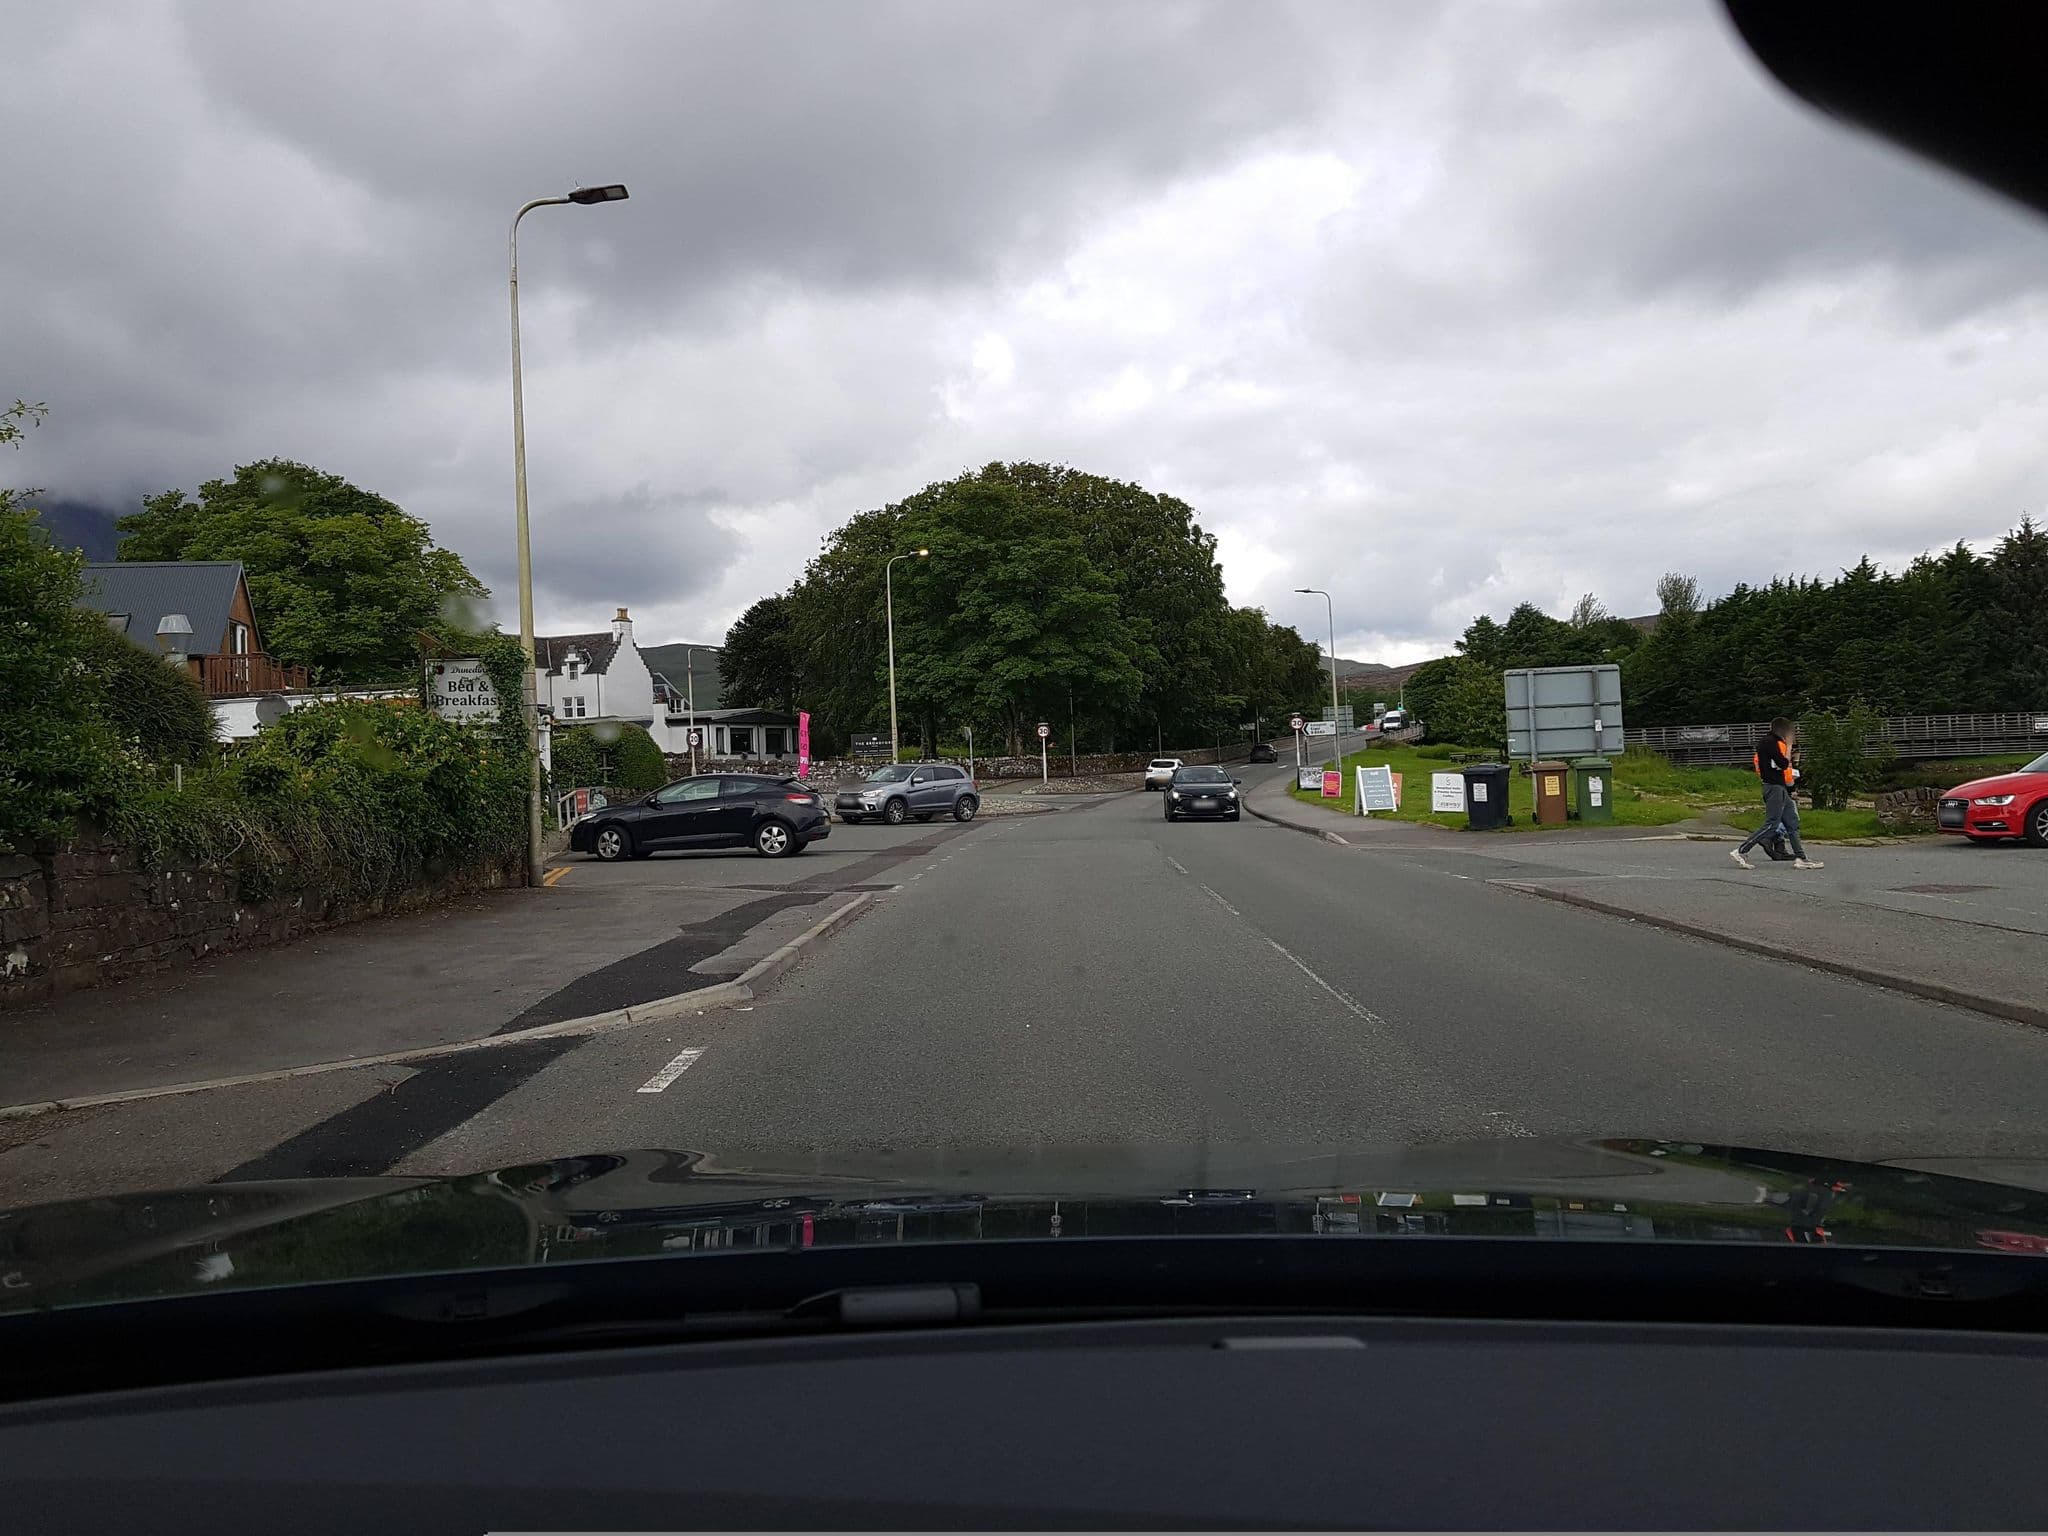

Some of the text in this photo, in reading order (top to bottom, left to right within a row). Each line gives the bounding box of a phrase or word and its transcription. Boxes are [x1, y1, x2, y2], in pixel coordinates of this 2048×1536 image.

[448, 680, 490, 692] Bed &
[436, 694, 499, 706] Breakfas
